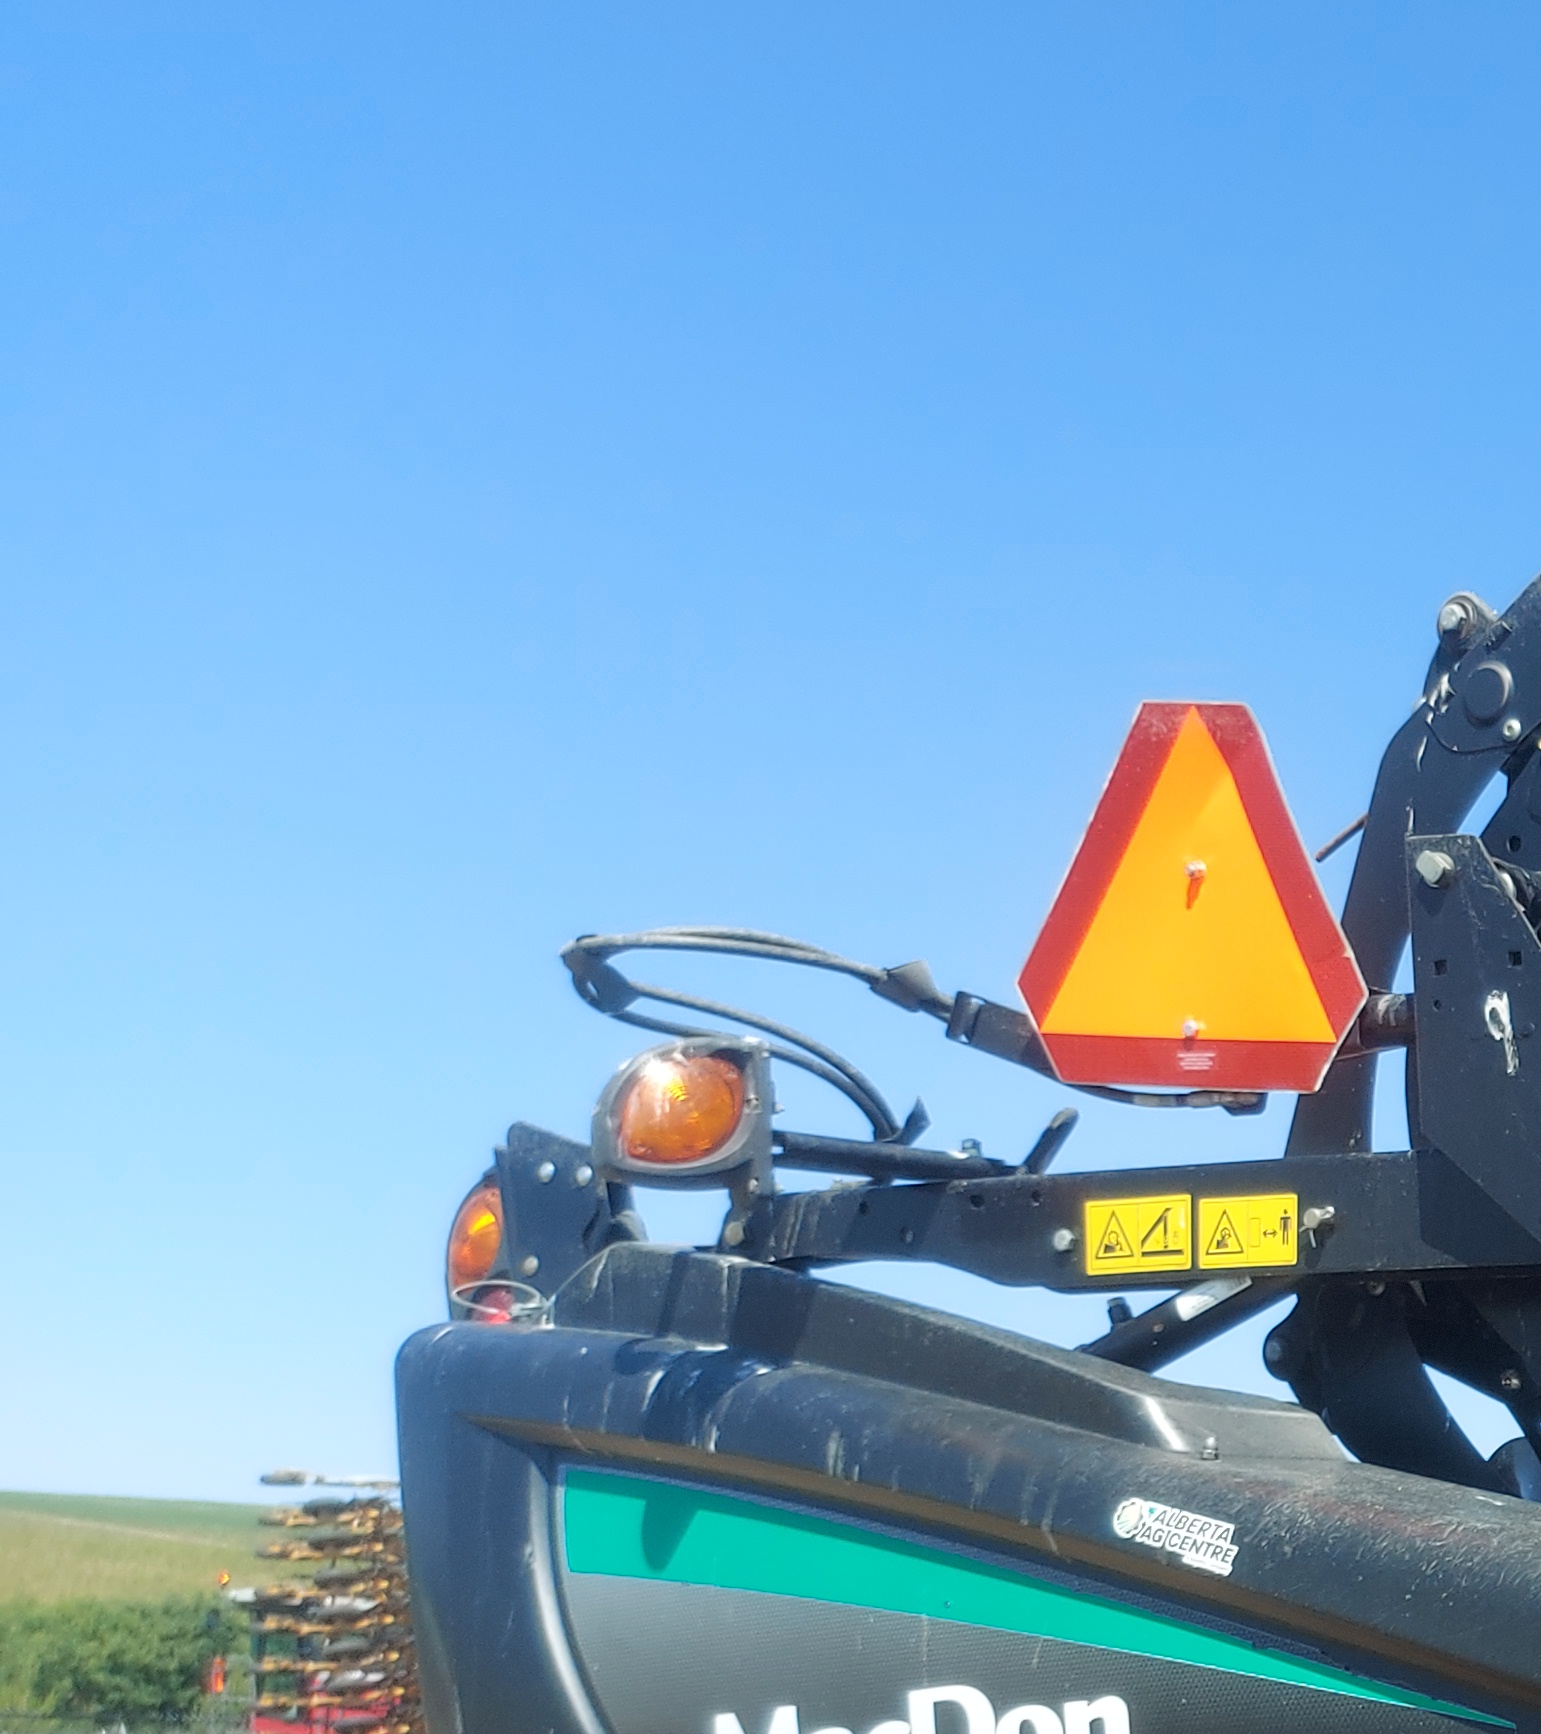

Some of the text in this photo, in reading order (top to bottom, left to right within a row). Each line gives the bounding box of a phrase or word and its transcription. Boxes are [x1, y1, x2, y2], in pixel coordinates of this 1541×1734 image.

[1153, 1510, 1231, 1543] ALBERTA
[1140, 1526, 1235, 1564] AG CENTRE
